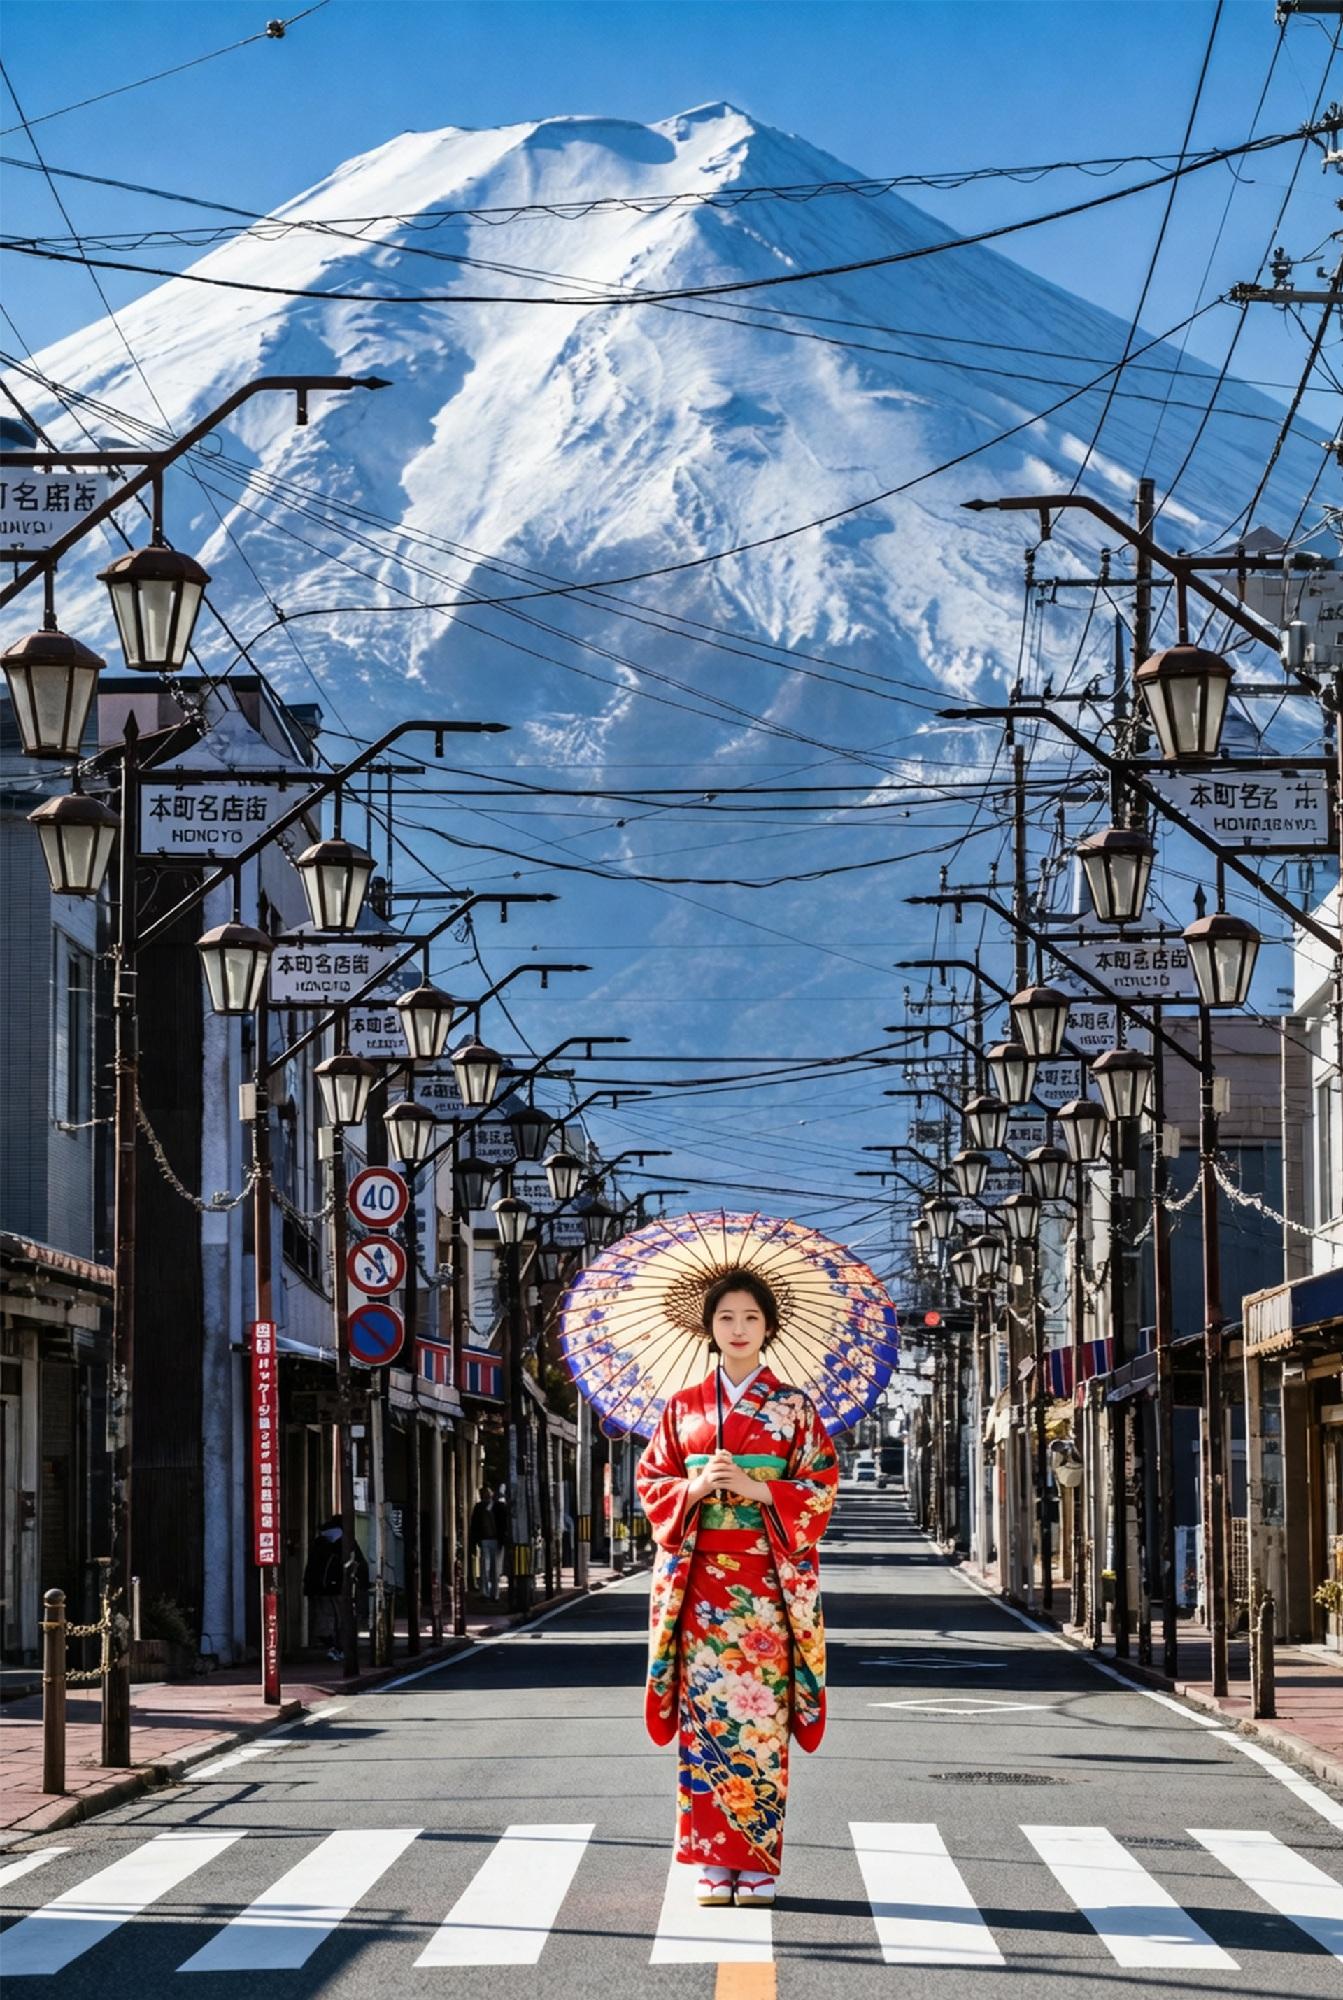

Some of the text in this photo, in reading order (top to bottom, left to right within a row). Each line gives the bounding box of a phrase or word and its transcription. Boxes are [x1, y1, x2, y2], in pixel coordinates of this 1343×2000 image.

[149, 794, 268, 822] 本町名店街
[362, 1184, 395, 1211] 40
